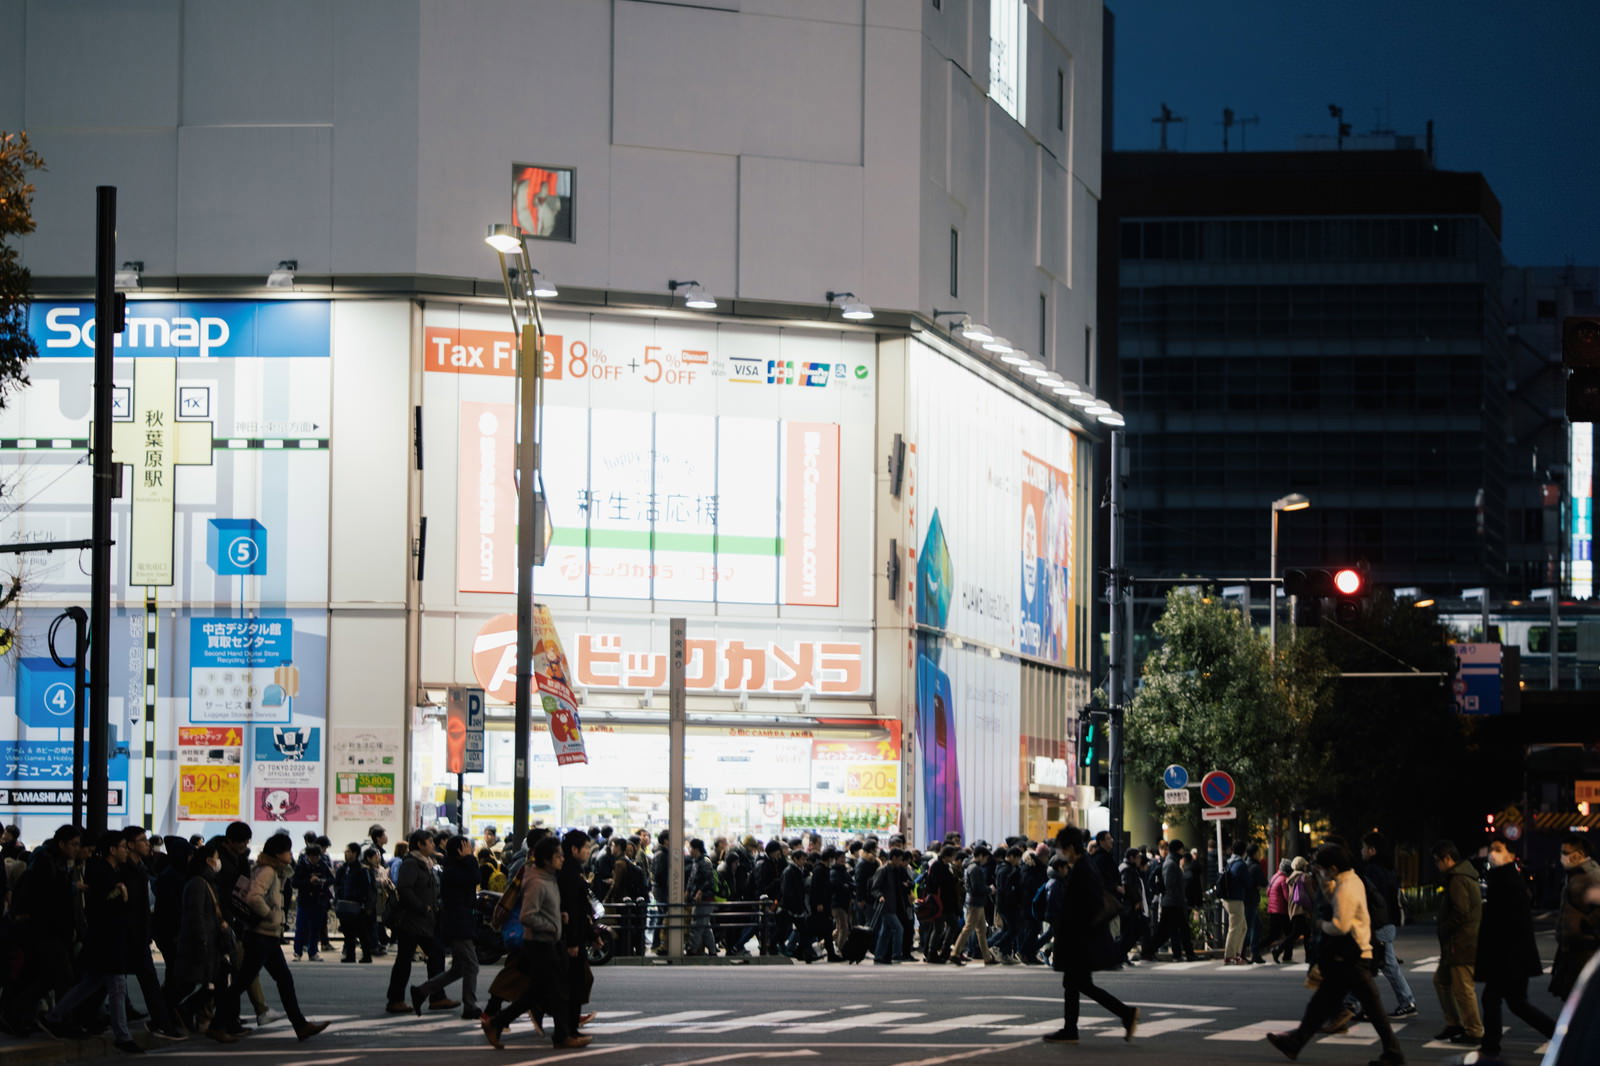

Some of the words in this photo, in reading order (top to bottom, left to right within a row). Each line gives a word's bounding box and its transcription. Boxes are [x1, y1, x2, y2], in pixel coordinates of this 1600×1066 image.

[432, 337, 484, 368] Tax
[493, 341, 555, 372] Fe
[592, 365, 624, 380] OFF
[665, 368, 697, 385] OFF
[735, 364, 760, 376] VISA
[144, 409, 164, 488] 秋葉原駅
[237, 543, 249, 562] 5
[203, 622, 282, 636] 中古デジタル館
[208, 636, 276, 648] 買取センター
[575, 633, 864, 693] ビックカメラ
[52, 689, 67, 708] 4
[469, 695, 481, 726] P
